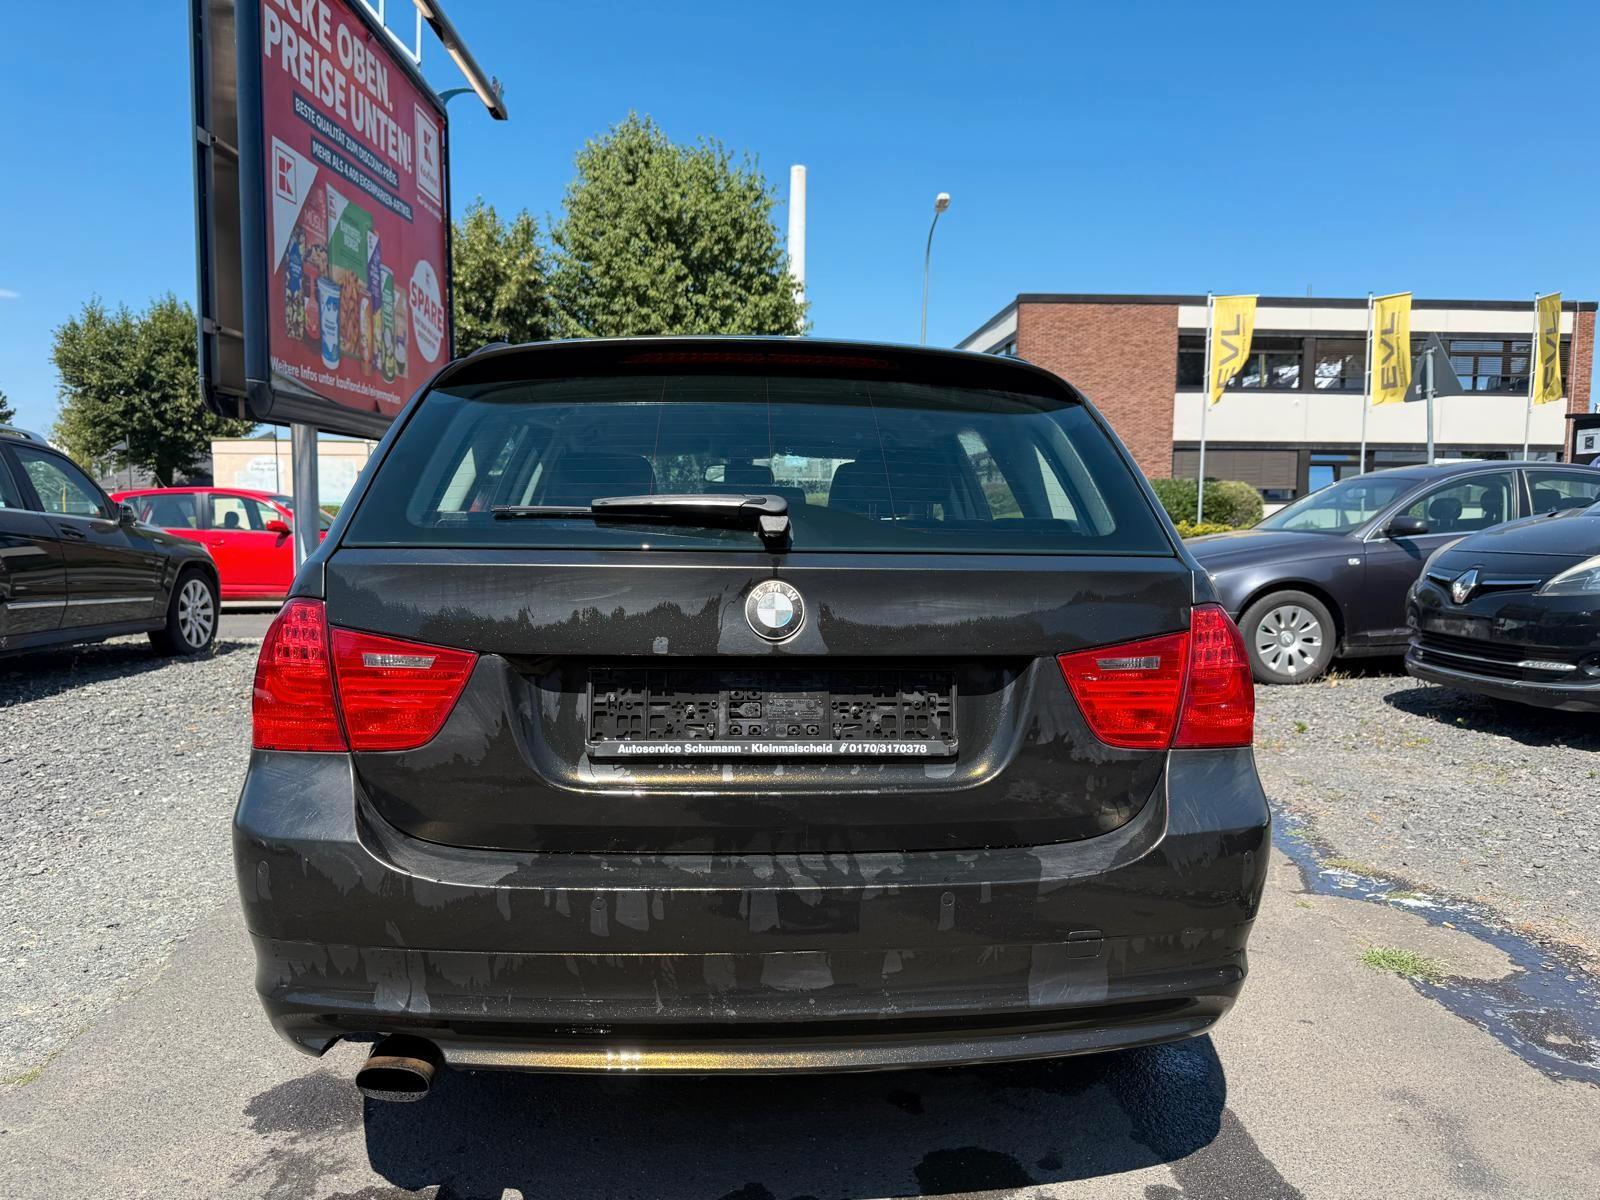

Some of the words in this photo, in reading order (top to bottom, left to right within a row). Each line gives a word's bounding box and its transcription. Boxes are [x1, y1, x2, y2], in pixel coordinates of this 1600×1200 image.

[264, 3, 347, 121] PREISE
[350, 84, 412, 174] UNTEN!
[336, 23, 393, 112] OBEN,
[295, 97, 316, 123] BESTE
[316, 115, 346, 146] QUALITÄT
[346, 137, 359, 156] ZUM
[313, 141, 331, 165] MEHR
[332, 155, 344, 172] ALS
[411, 282, 443, 332] SPARE
[271, 355, 299, 377] Weitere
[301, 364, 317, 382] Infos
[319, 373, 335, 386] unter
[1217, 314, 1240, 389] EVL
[1380, 312, 1398, 390] EVL
[752, 583, 798, 602] BMW
[617, 744, 682, 754] Autoservice
[684, 744, 741, 754] Schumann
[751, 743, 833, 754] Kleinmaischeid
[849, 743, 927, 755] 0170/3170378
